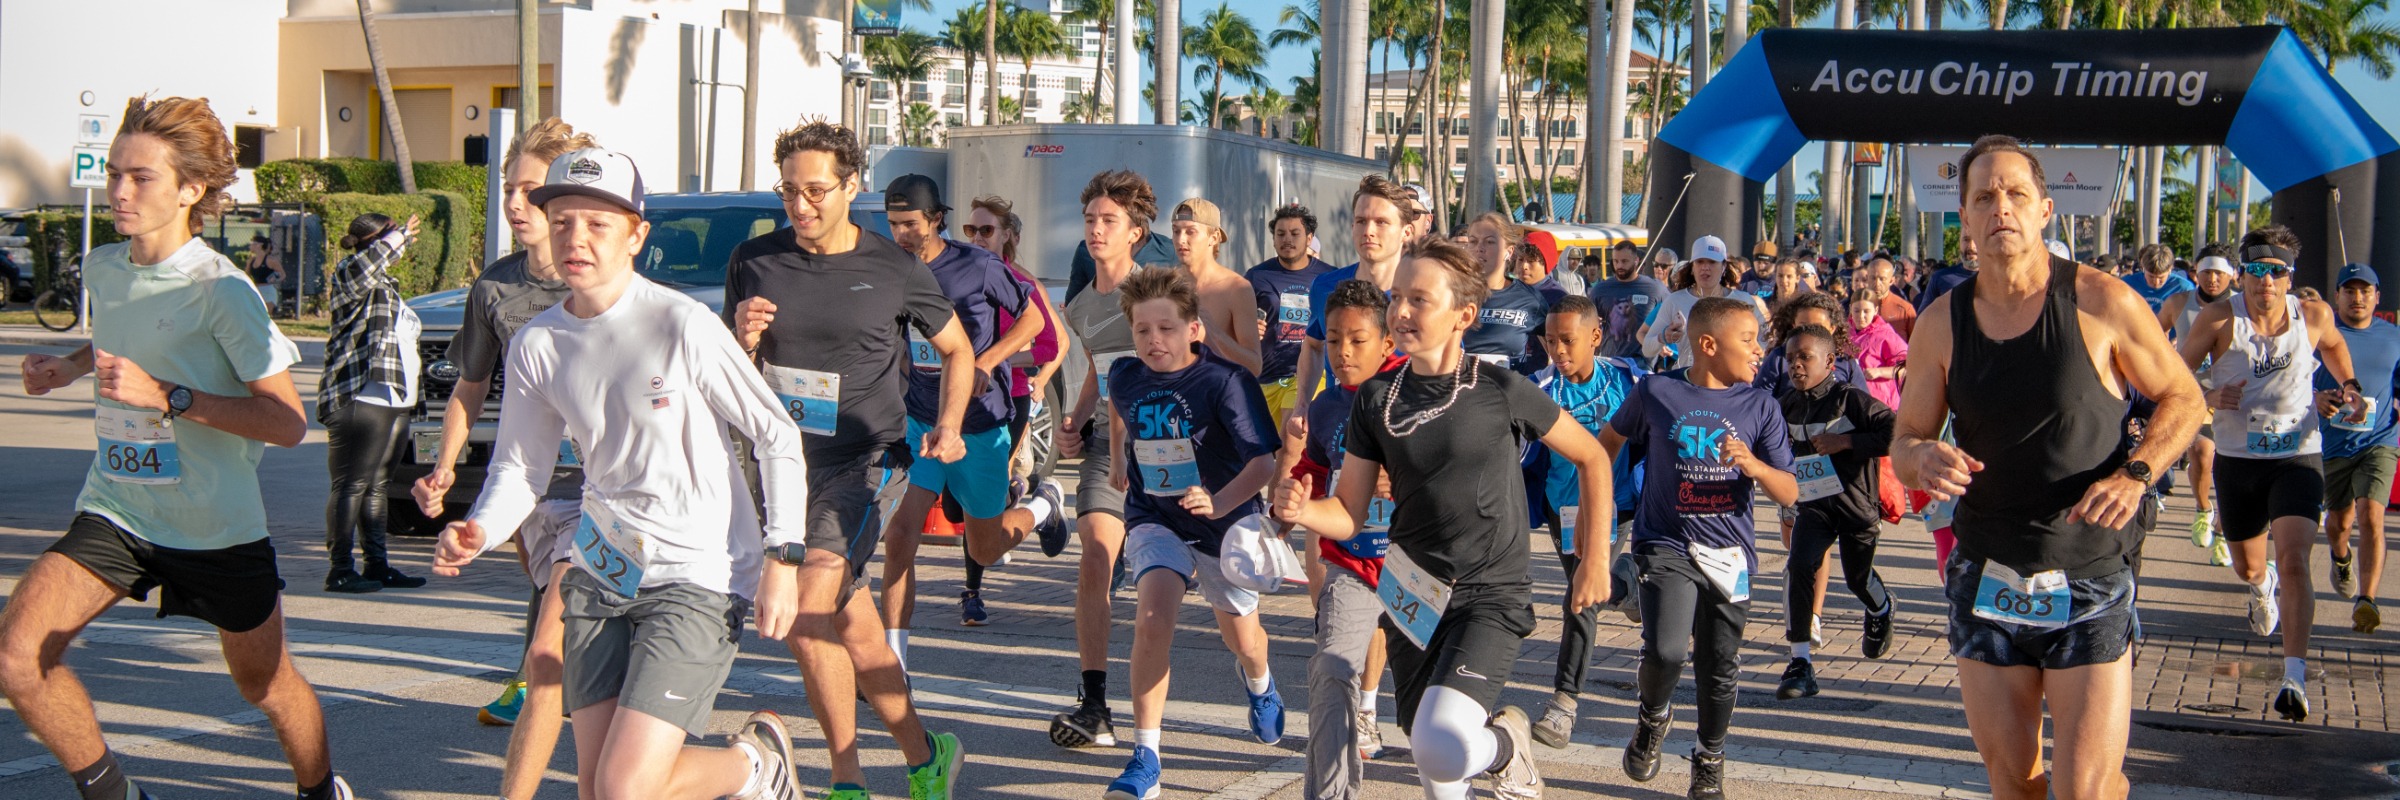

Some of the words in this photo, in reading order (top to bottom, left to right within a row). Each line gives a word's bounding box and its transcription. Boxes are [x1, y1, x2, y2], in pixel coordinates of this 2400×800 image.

[2051, 62, 2208, 106] Timing
[1031, 144, 1064, 157] pace
[2076, 183, 2102, 191] Moore
[1286, 309, 1311, 321] 693
[1172, 391, 1193, 420] IMPACT
[1137, 402, 1177, 440] 5K
[1668, 414, 1687, 440] URBAN
[1689, 409, 1720, 420] YOUTH
[1331, 422, 1345, 452] URBAN
[1677, 424, 1726, 462] 5K
[2257, 434, 2293, 451] 439
[107, 444, 163, 474] 684
[1675, 463, 1692, 471] FALL
[1157, 467, 1172, 489] 2
[584, 526, 628, 588] 752
[1390, 585, 1421, 625] 34
[1994, 587, 2053, 617] 683
